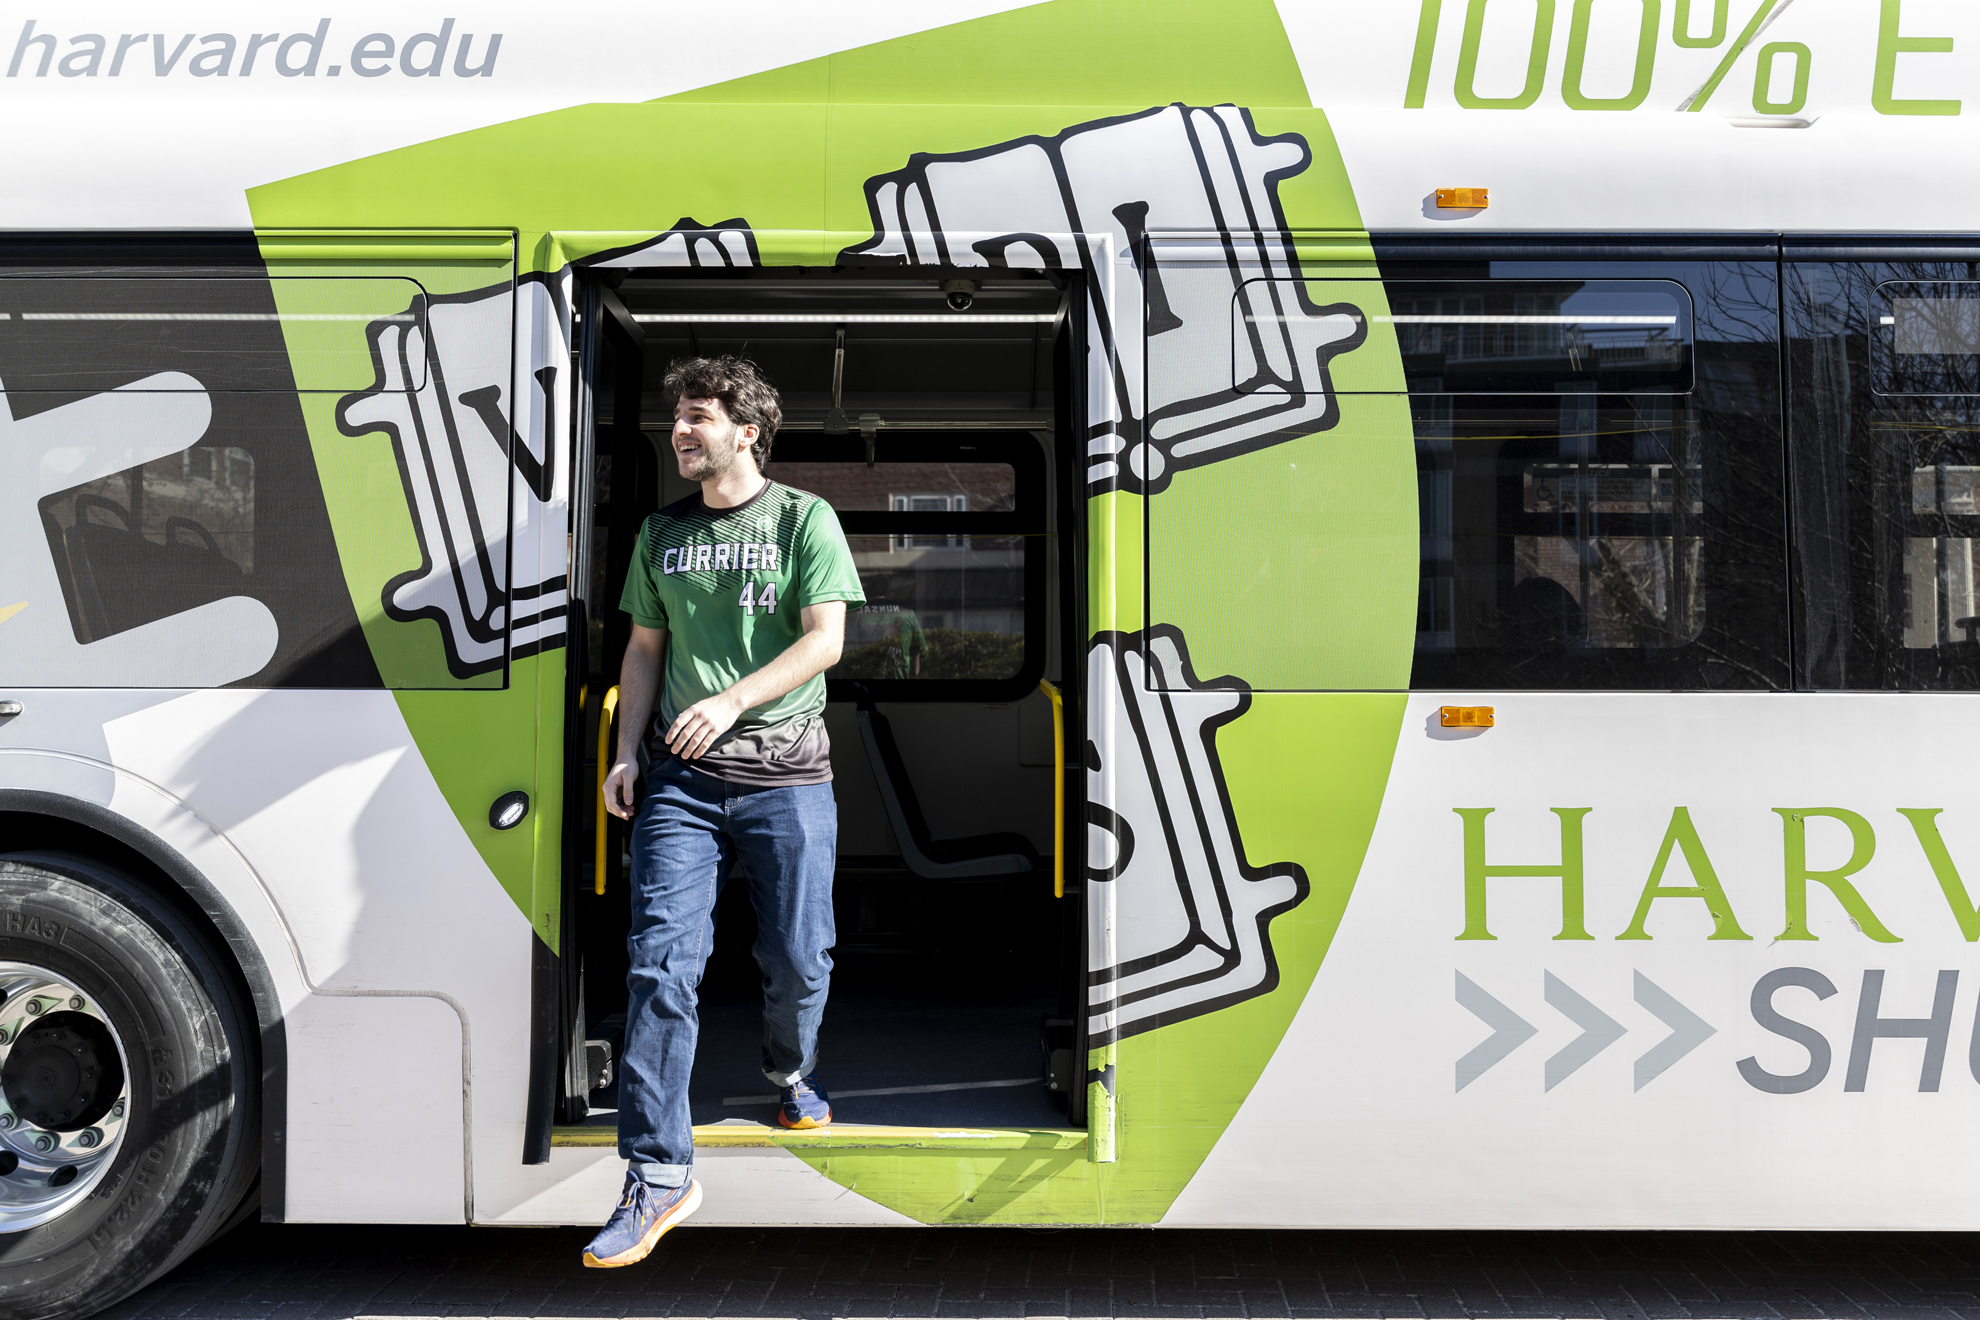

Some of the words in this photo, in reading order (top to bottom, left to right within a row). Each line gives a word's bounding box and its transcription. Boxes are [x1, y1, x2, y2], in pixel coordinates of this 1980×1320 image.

[6, 17, 503, 78] harvard.edu
[1404, 0, 1811, 115] 100%
[1573, 469, 1611, 477] NTICE
[663, 541, 779, 575] CURRIER
[738, 581, 778, 616] 44
[6, 912, 61, 941] HA3
[1735, 966, 1980, 1095] SH
[92, 1189, 143, 1247] 22.5
